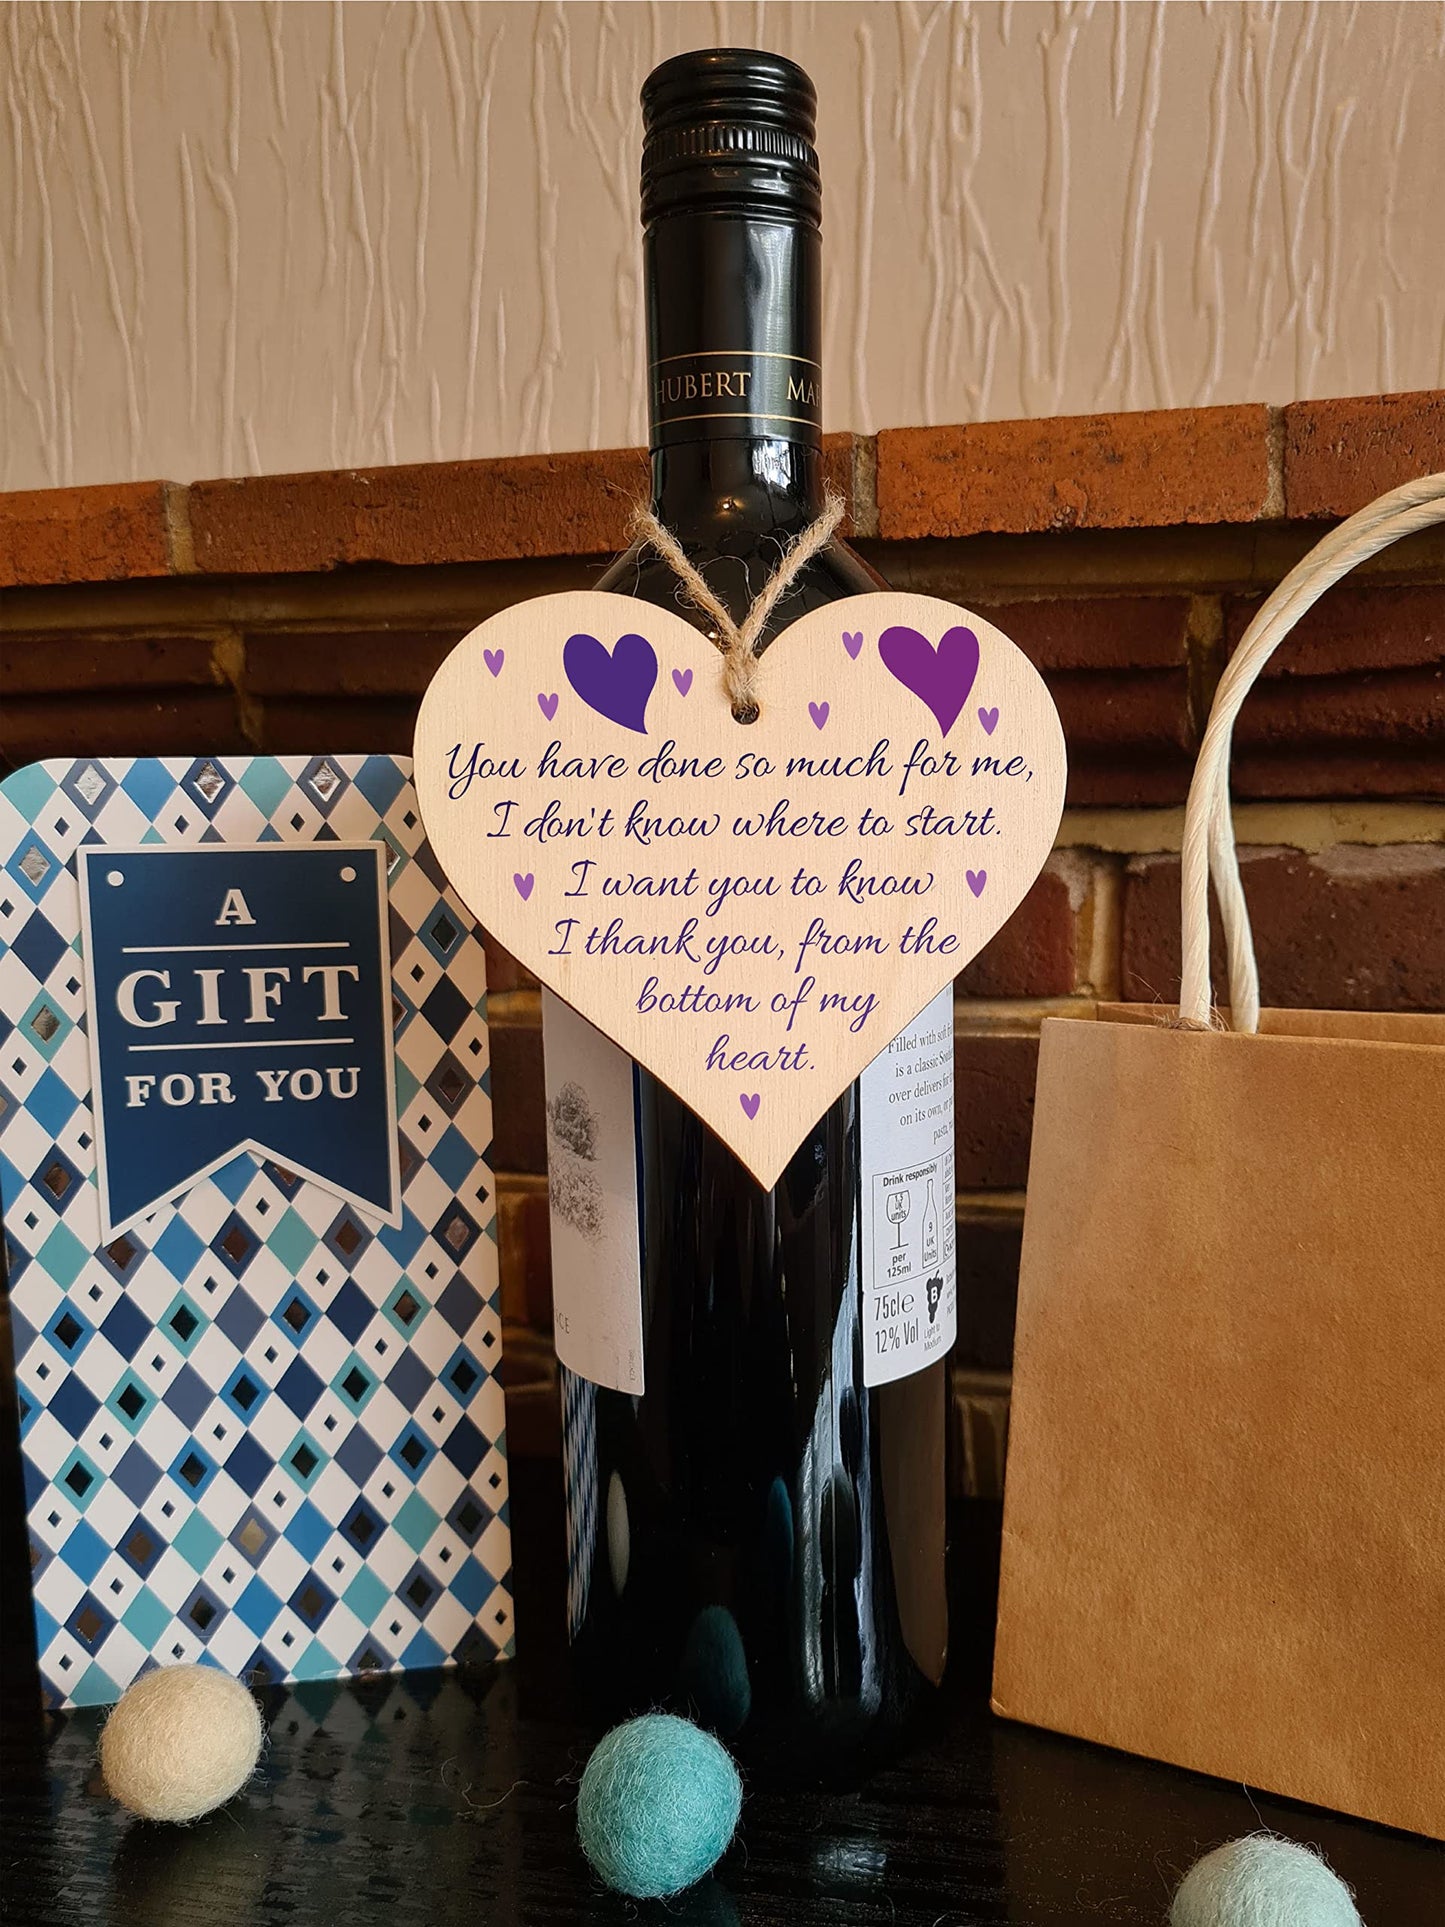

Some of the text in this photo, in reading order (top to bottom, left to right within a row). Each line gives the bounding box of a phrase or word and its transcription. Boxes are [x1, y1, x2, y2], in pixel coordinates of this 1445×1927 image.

[655, 371, 752, 407] HUBERT
[445, 737, 1035, 803] You have done so much for me,
[486, 799, 1002, 846] I don't know where to start.
[564, 857, 935, 917] I want you to know
[215, 888, 257, 926] A
[547, 916, 961, 976] I thank you, from the
[116, 965, 360, 1028] GIFT
[635, 975, 882, 1033] bottom of my
[705, 1033, 816, 1072] heart.
[888, 1033, 917, 1053] Filled
[919, 1029, 936, 1046] with
[895, 1062, 904, 1077] is
[906, 1064, 912, 1075] a
[914, 1055, 938, 1073] classic
[124, 1067, 361, 1108] FOR YOU
[888, 1089, 912, 1104] over
[913, 1079, 942, 1098] delivers
[899, 1113, 913, 1126] on
[914, 1107, 926, 1122] its
[882, 1173, 904, 1187] Drink
[905, 1161, 938, 1182] responsibly
[926, 1236, 935, 1247] UK
[928, 1221, 933, 1233] 9
[887, 1261, 912, 1278] 125ml
[891, 1252, 907, 1267] per
[930, 1286, 938, 1304] B
[875, 1317, 919, 1354] 12% Vol
